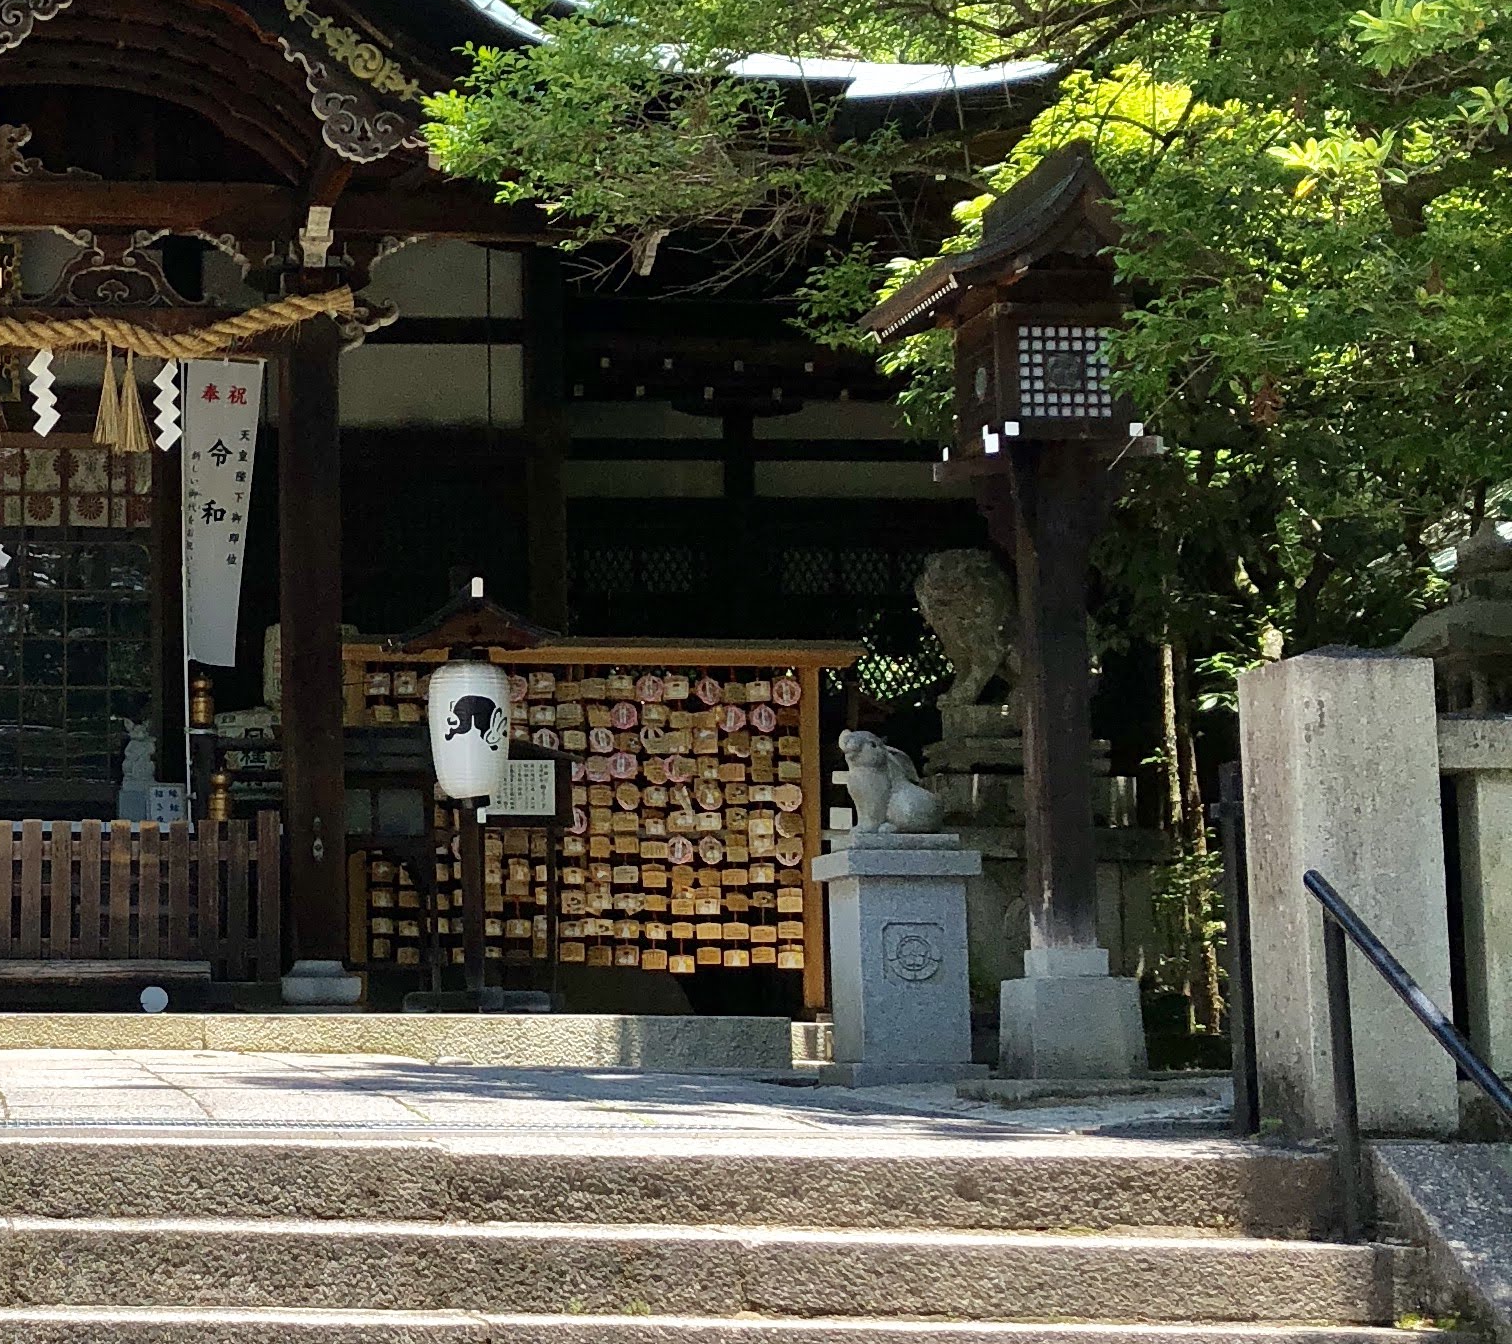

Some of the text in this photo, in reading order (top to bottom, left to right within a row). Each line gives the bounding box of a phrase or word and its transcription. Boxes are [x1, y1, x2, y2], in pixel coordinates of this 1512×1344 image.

[201, 383, 248, 405] 奉祝
[201, 438, 234, 525] 令和
[226, 429, 251, 566] 天皇陛下御即位
